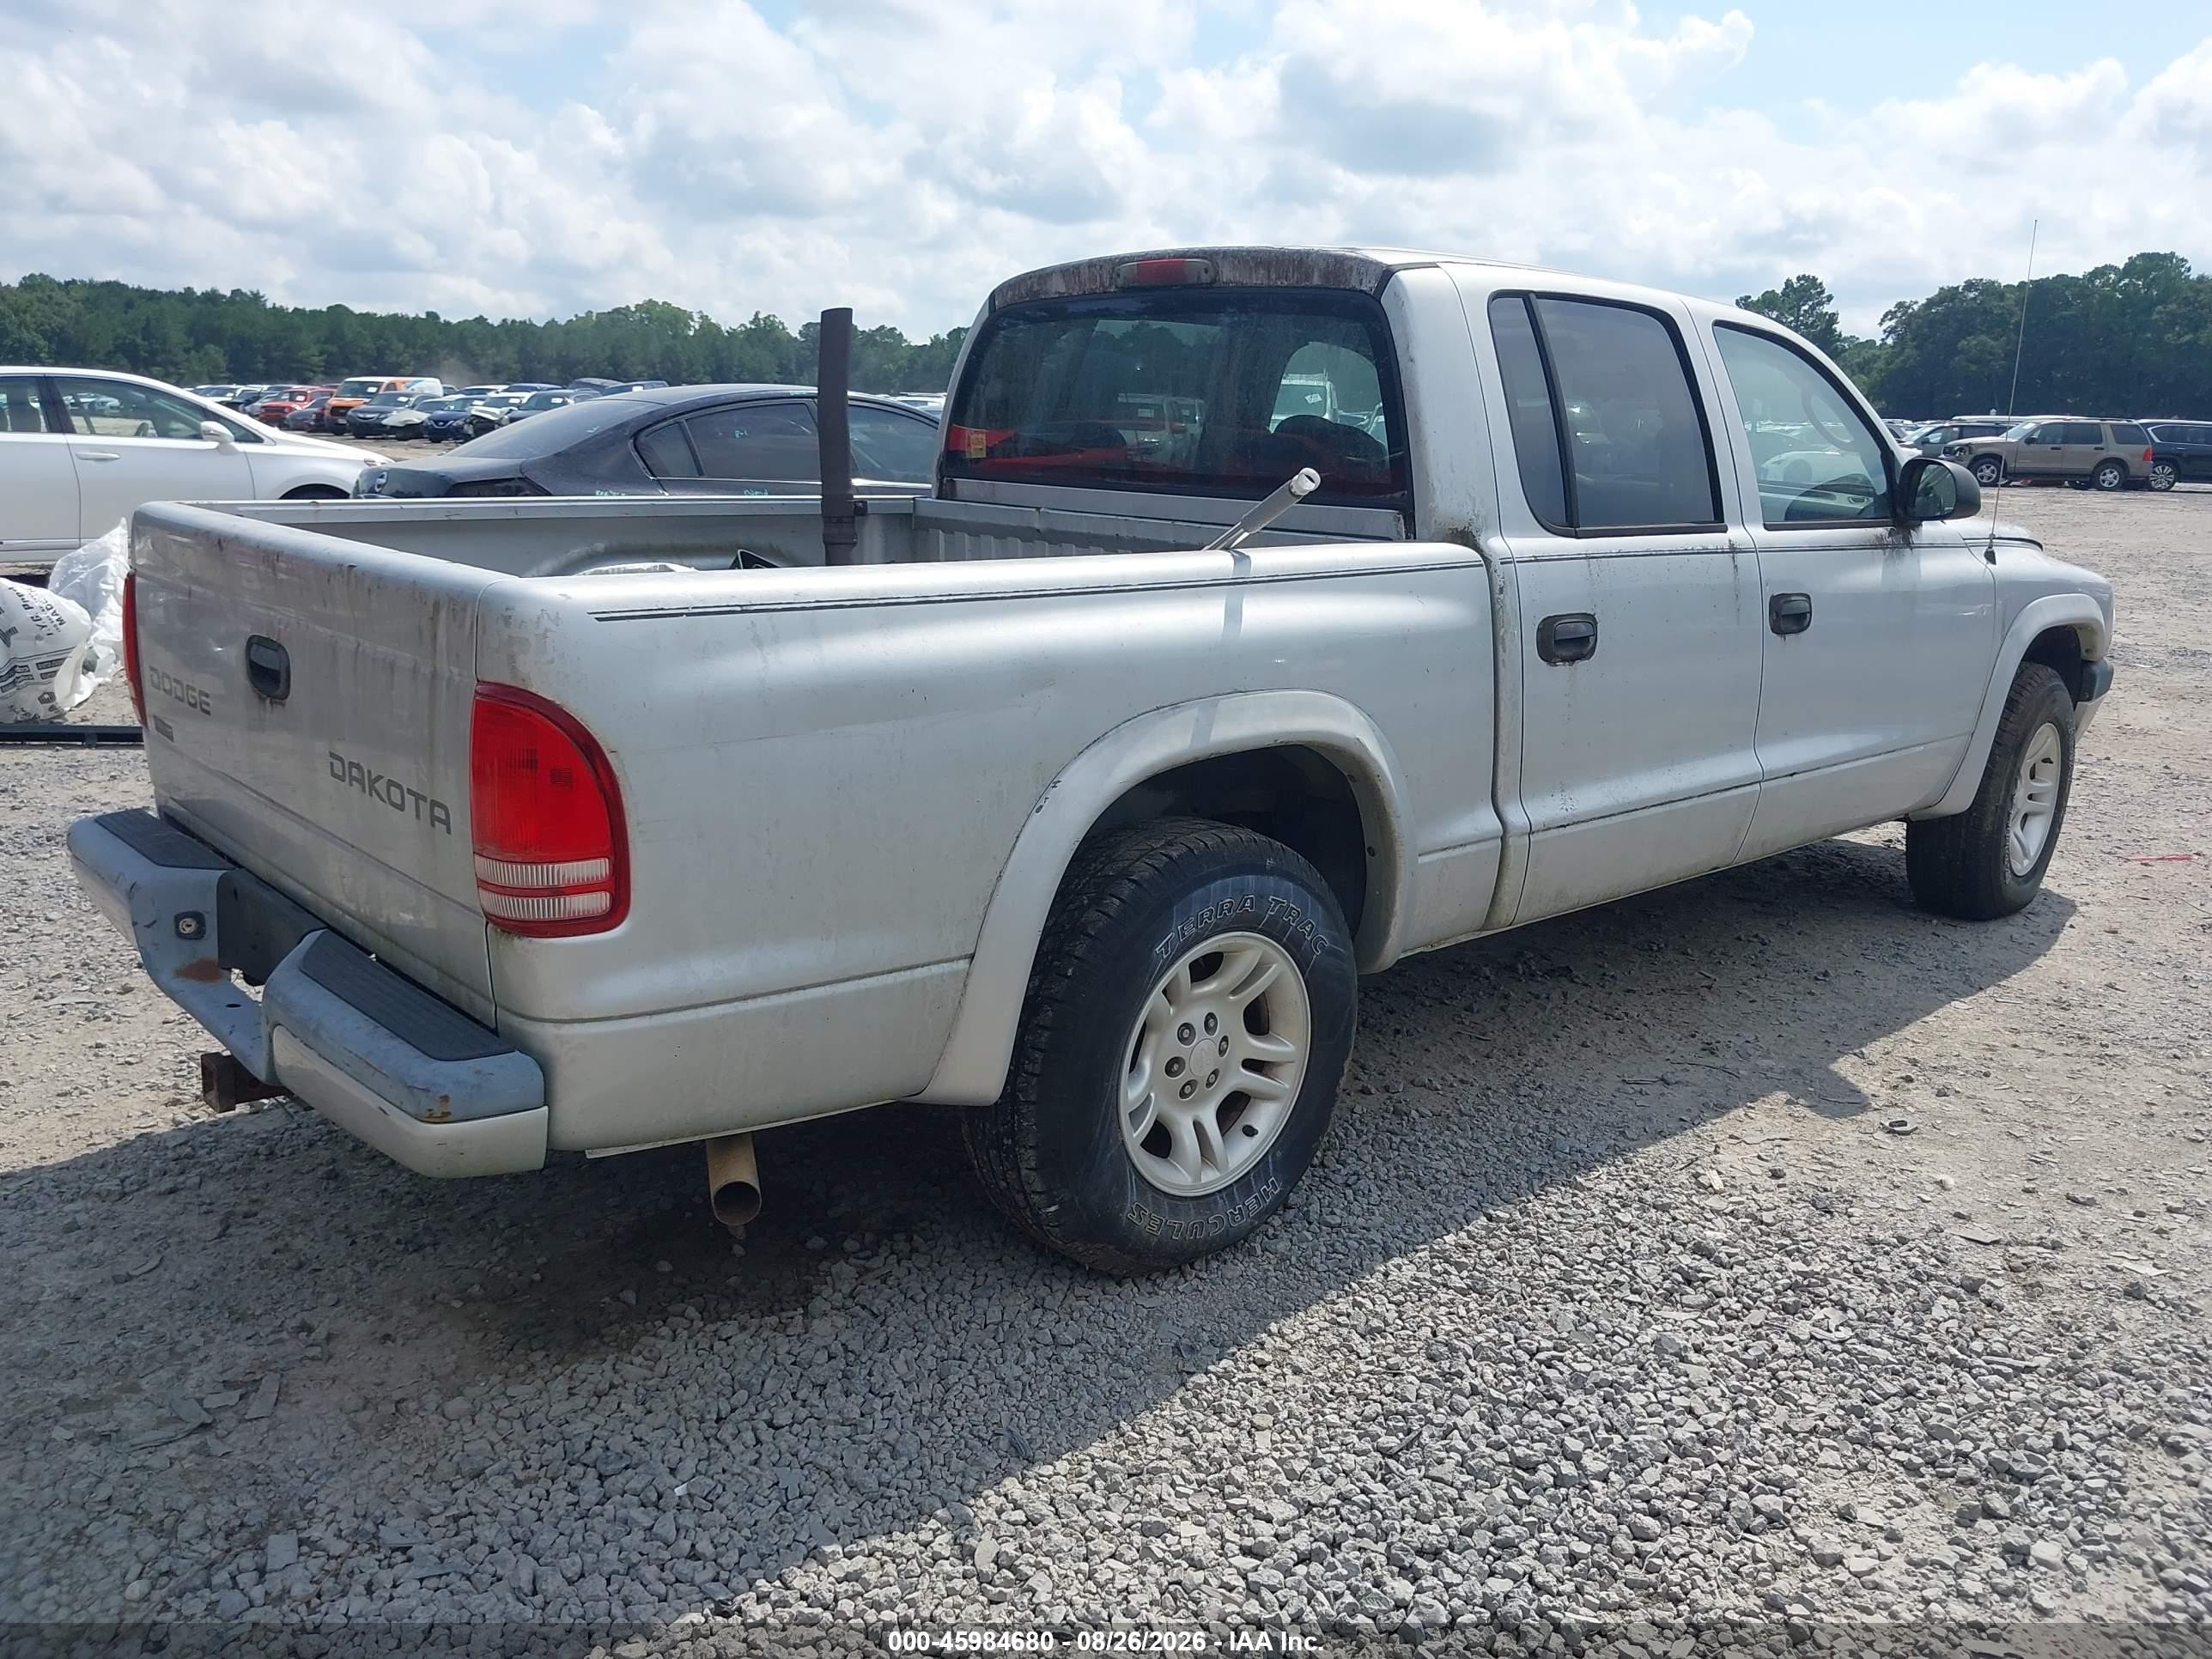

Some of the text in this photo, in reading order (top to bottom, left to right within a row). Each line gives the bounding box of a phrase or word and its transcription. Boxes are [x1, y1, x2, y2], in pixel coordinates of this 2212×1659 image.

[149, 665, 211, 716] DODGE
[329, 750, 452, 836] DAKOTA
[1154, 894, 1329, 959] TERRA TRAC
[1127, 1176, 1281, 1241] HERCULES
